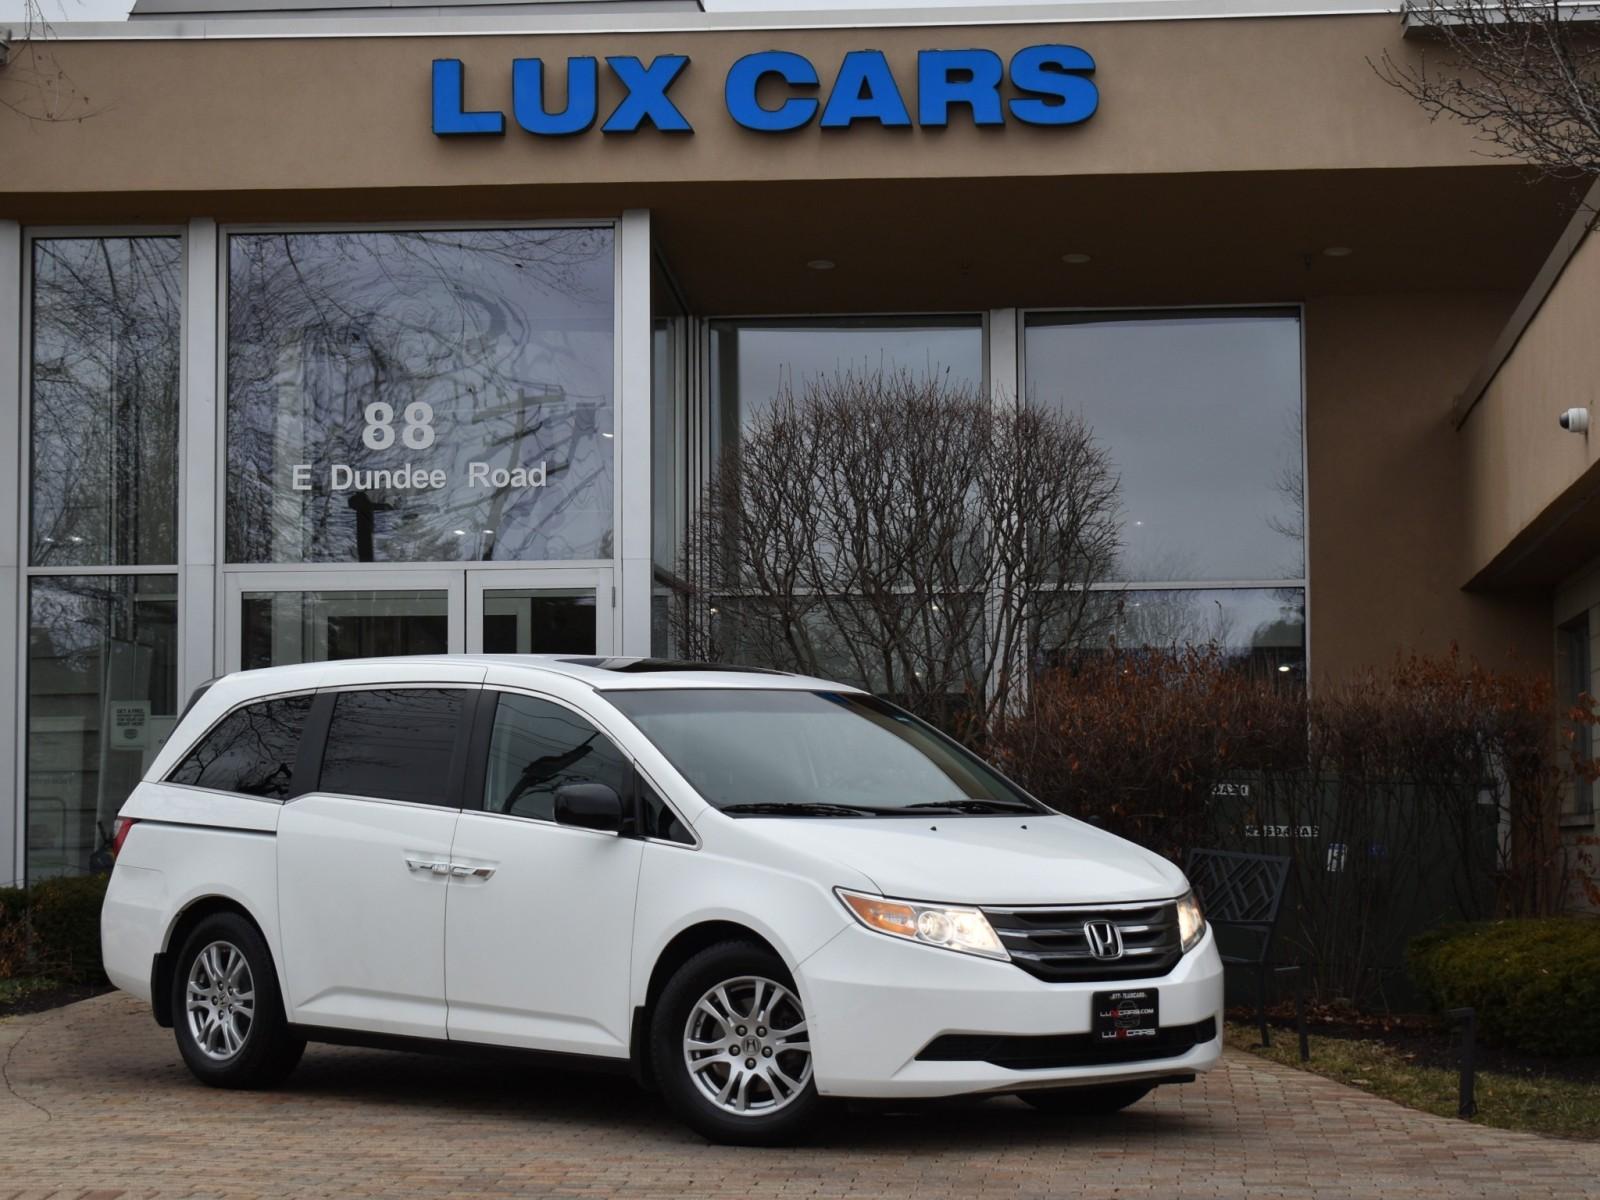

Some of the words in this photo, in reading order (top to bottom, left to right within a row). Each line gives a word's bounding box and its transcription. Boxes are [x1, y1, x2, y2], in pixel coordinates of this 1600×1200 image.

[432, 55, 694, 137] LUX
[725, 44, 1099, 132] CARS
[362, 401, 435, 450] 88
[292, 464, 313, 490] E
[331, 463, 447, 489] Dundee
[468, 461, 547, 488] Road
